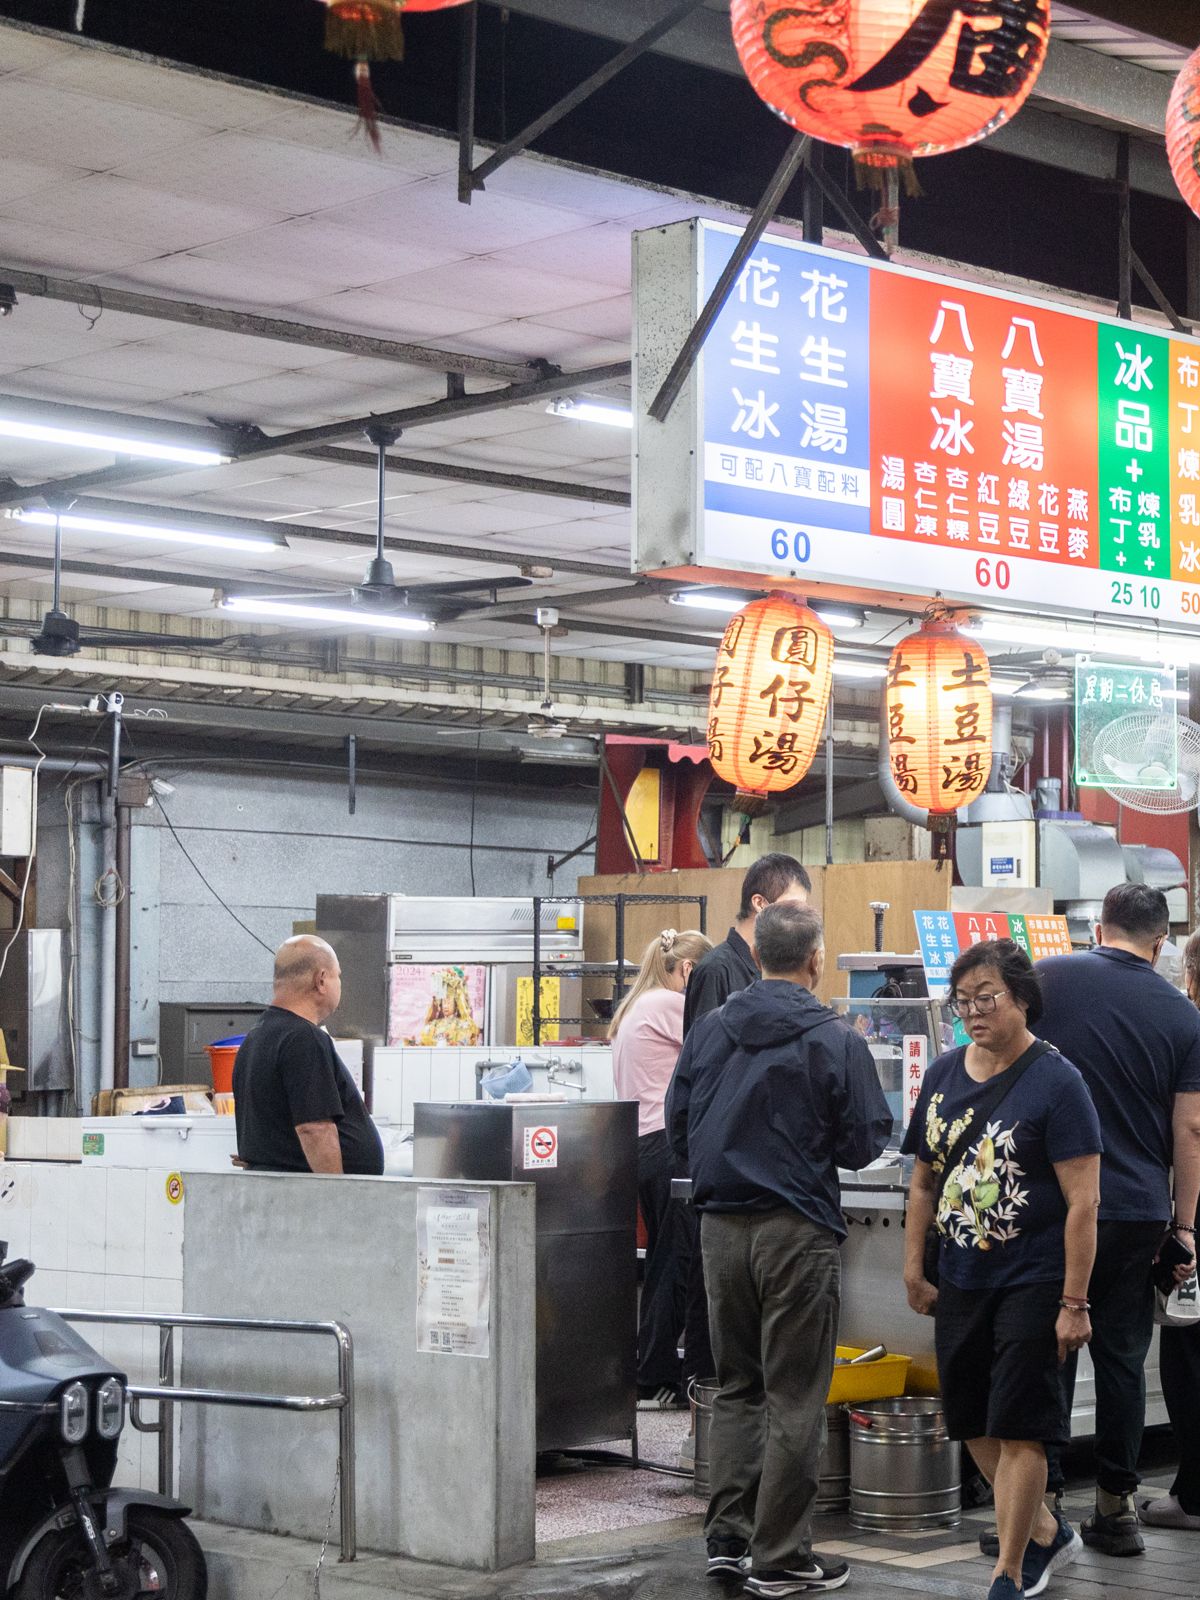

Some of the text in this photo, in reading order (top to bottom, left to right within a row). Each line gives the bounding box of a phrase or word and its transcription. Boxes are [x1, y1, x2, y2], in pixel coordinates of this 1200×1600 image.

[730, 257, 781, 441] 花生冰
[799, 269, 849, 455] 花生湯
[928, 300, 976, 456] 八寶冰
[1000, 315, 1045, 471] 八寶湯
[719, 452, 860, 499] 可配八寶配料
[881, 455, 906, 533] 湯圓
[1177, 356, 1200, 572] 布丁煉乳冰
[946, 466, 970, 543] 杏仁粿
[976, 472, 1000, 545] 紅豆
[1008, 477, 1031, 549] 綠豆
[1038, 483, 1061, 554] 花豆
[1067, 487, 1090, 560] 燕麥
[770, 527, 812, 563] 60
[974, 557, 1011, 590] 60
[1111, 580, 1133, 606] 25
[1139, 585, 1161, 610] 10
[749, 624, 819, 775] 圓仔湯
[941, 652, 988, 793] 土豆湯
[1081, 674, 1164, 708] 星期二休息
[909, 1040, 921, 1118] 請先付
